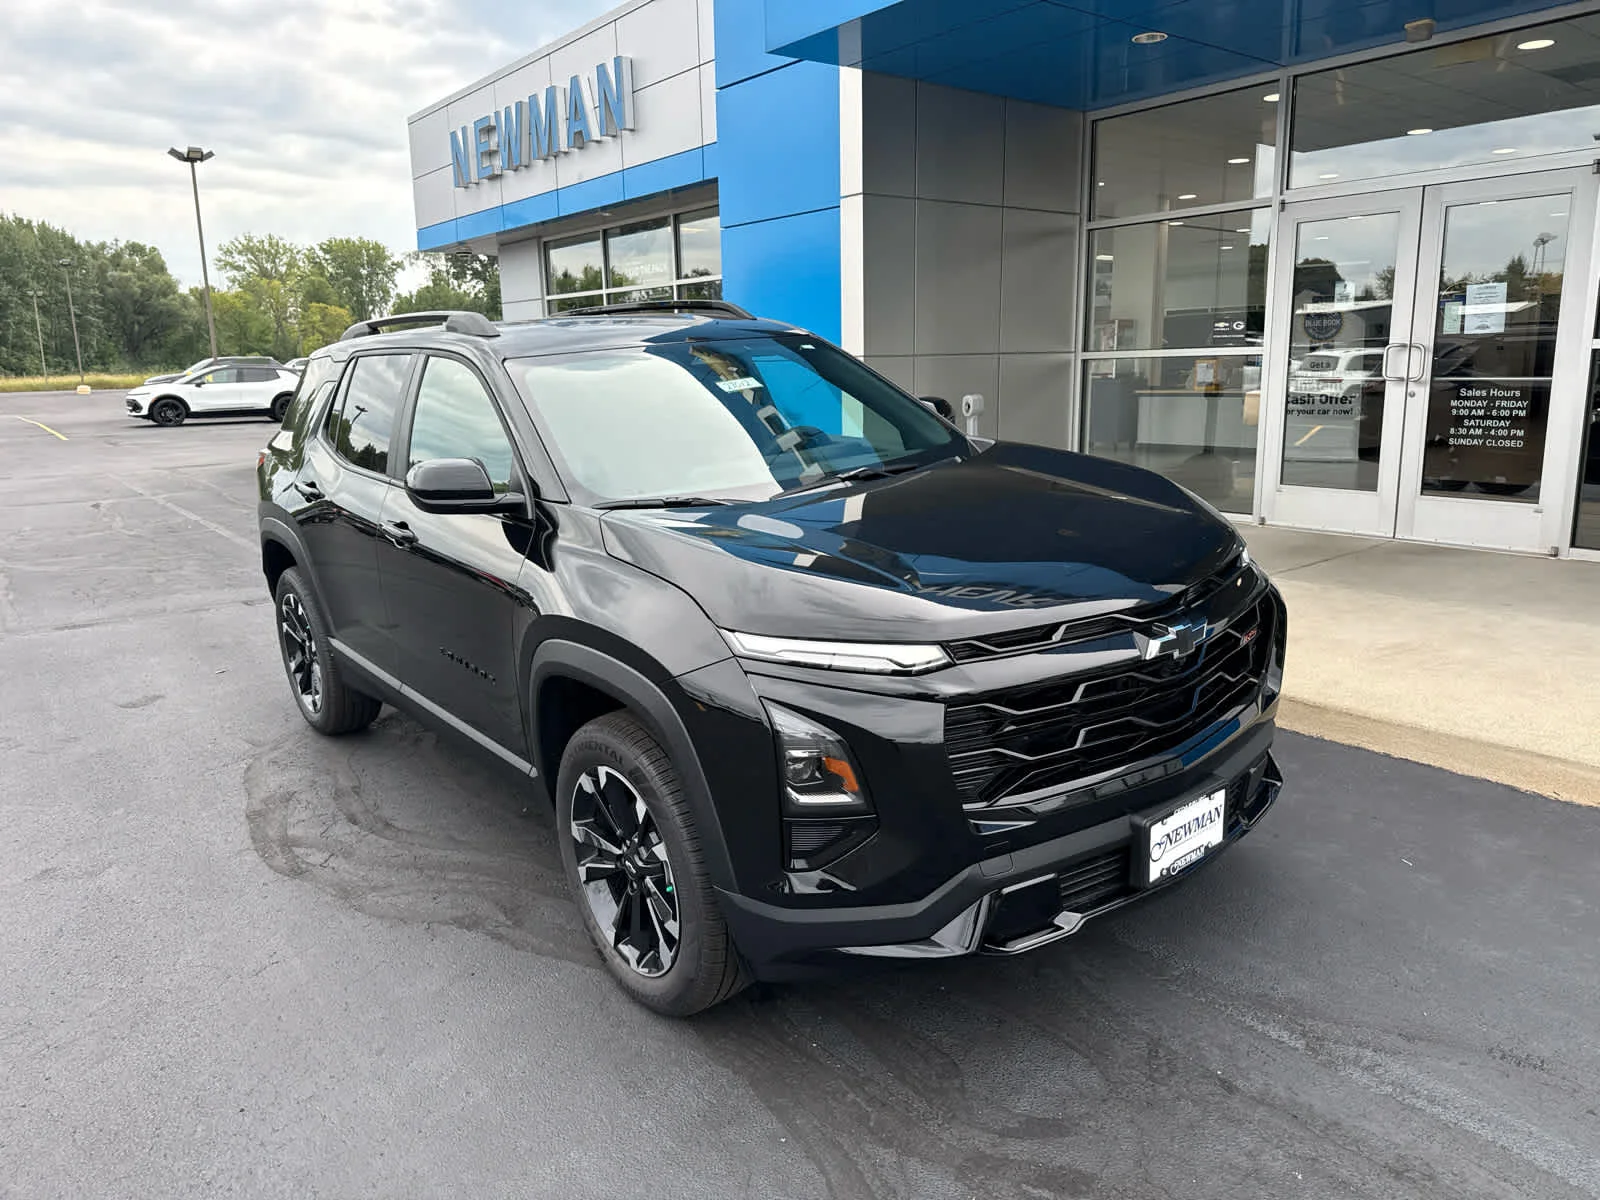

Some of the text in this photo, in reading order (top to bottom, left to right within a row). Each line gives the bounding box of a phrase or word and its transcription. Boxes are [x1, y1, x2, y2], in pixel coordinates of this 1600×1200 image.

[450, 56, 633, 188] NEWMAN
[1310, 361, 1324, 369] Get
[1459, 387, 1521, 397] Sales Hours
[1287, 393, 1316, 405] ash
[1450, 399, 1488, 407] MONDAY
[1495, 400, 1529, 408] FRIDAY
[1491, 409, 1510, 417] 6:00
[1512, 409, 1527, 417] PM
[1463, 419, 1511, 427] SATURDAY
[1489, 428, 1509, 436] 4:00
[1510, 429, 1525, 437] PM
[1448, 437, 1524, 448] SUNDAY CLOSED
[1150, 805, 1223, 862] NEWMAN
